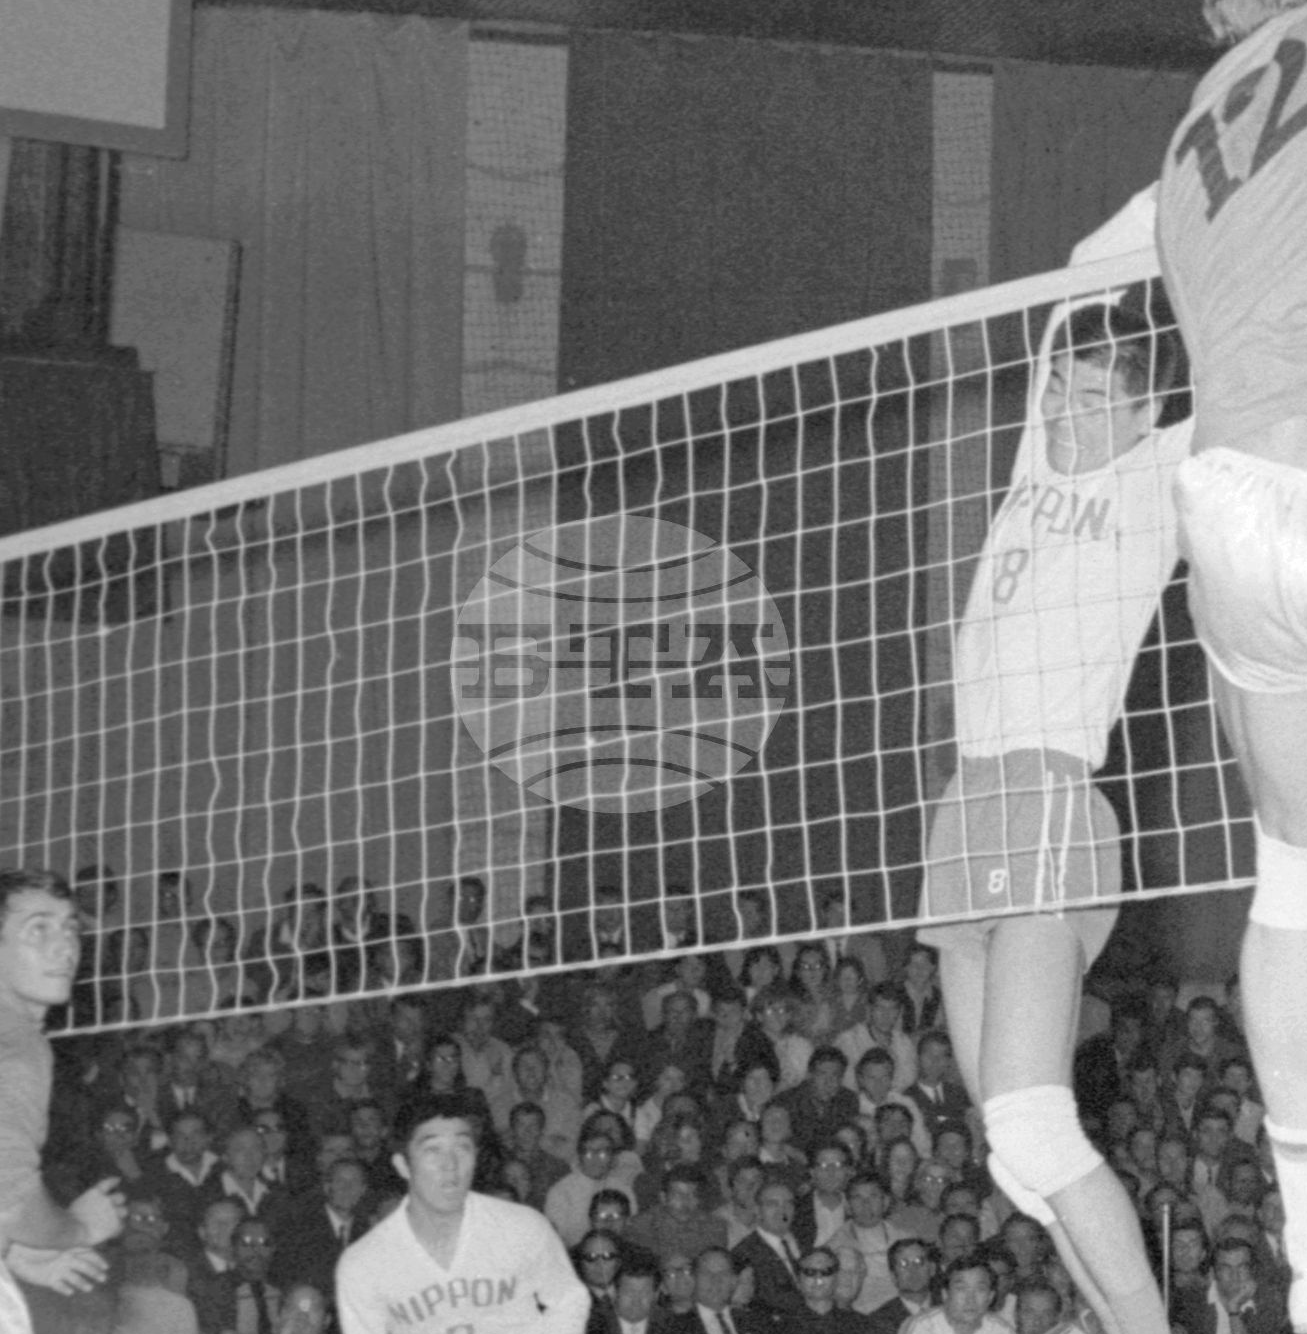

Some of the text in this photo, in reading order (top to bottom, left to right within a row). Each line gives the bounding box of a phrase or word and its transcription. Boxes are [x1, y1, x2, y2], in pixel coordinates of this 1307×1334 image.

[992, 548, 1030, 605] 8
[988, 868, 1007, 894] 8
[387, 1275, 517, 1326] NIPPON
